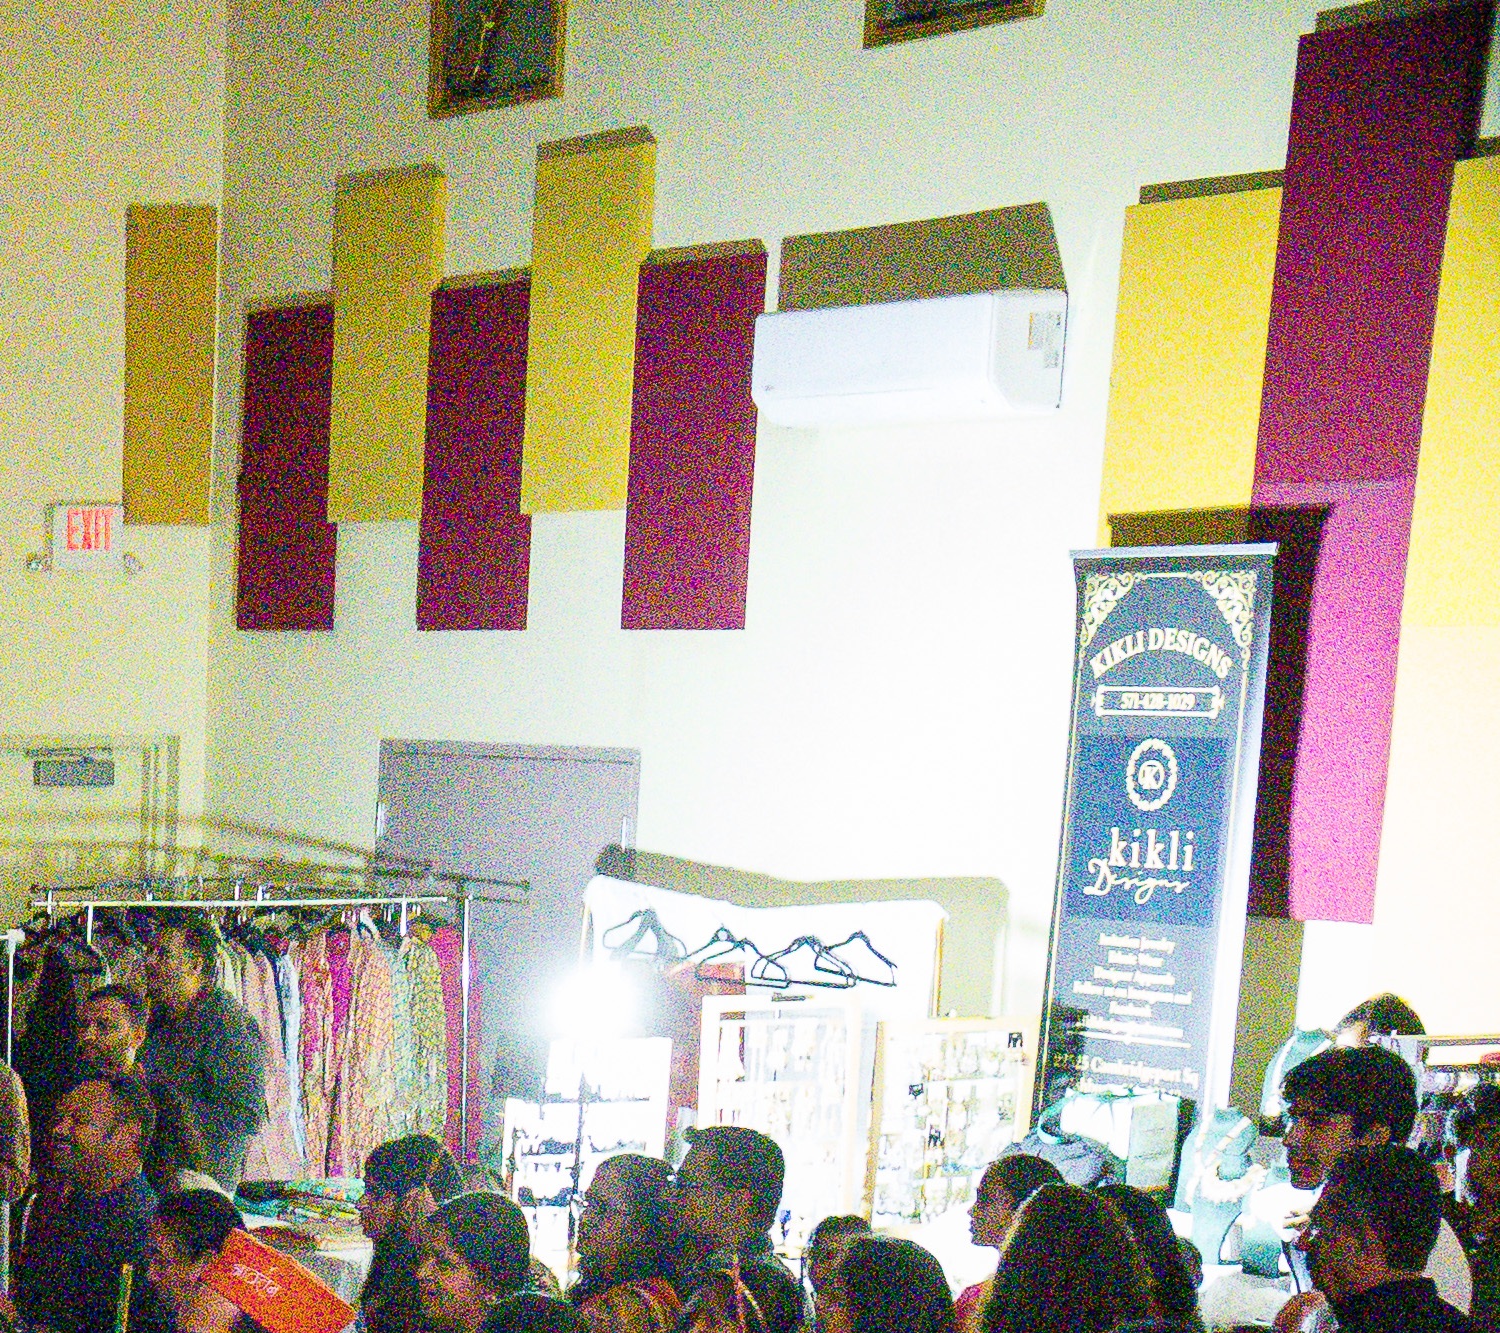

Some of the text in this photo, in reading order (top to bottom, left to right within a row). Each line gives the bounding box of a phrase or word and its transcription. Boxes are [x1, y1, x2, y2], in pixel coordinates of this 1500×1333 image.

[66, 507, 114, 551] EXIT
[1089, 626, 1234, 681] KIKLI DESIGNS
[1109, 828, 1196, 872] kikli
[1083, 857, 1190, 906] Designs
